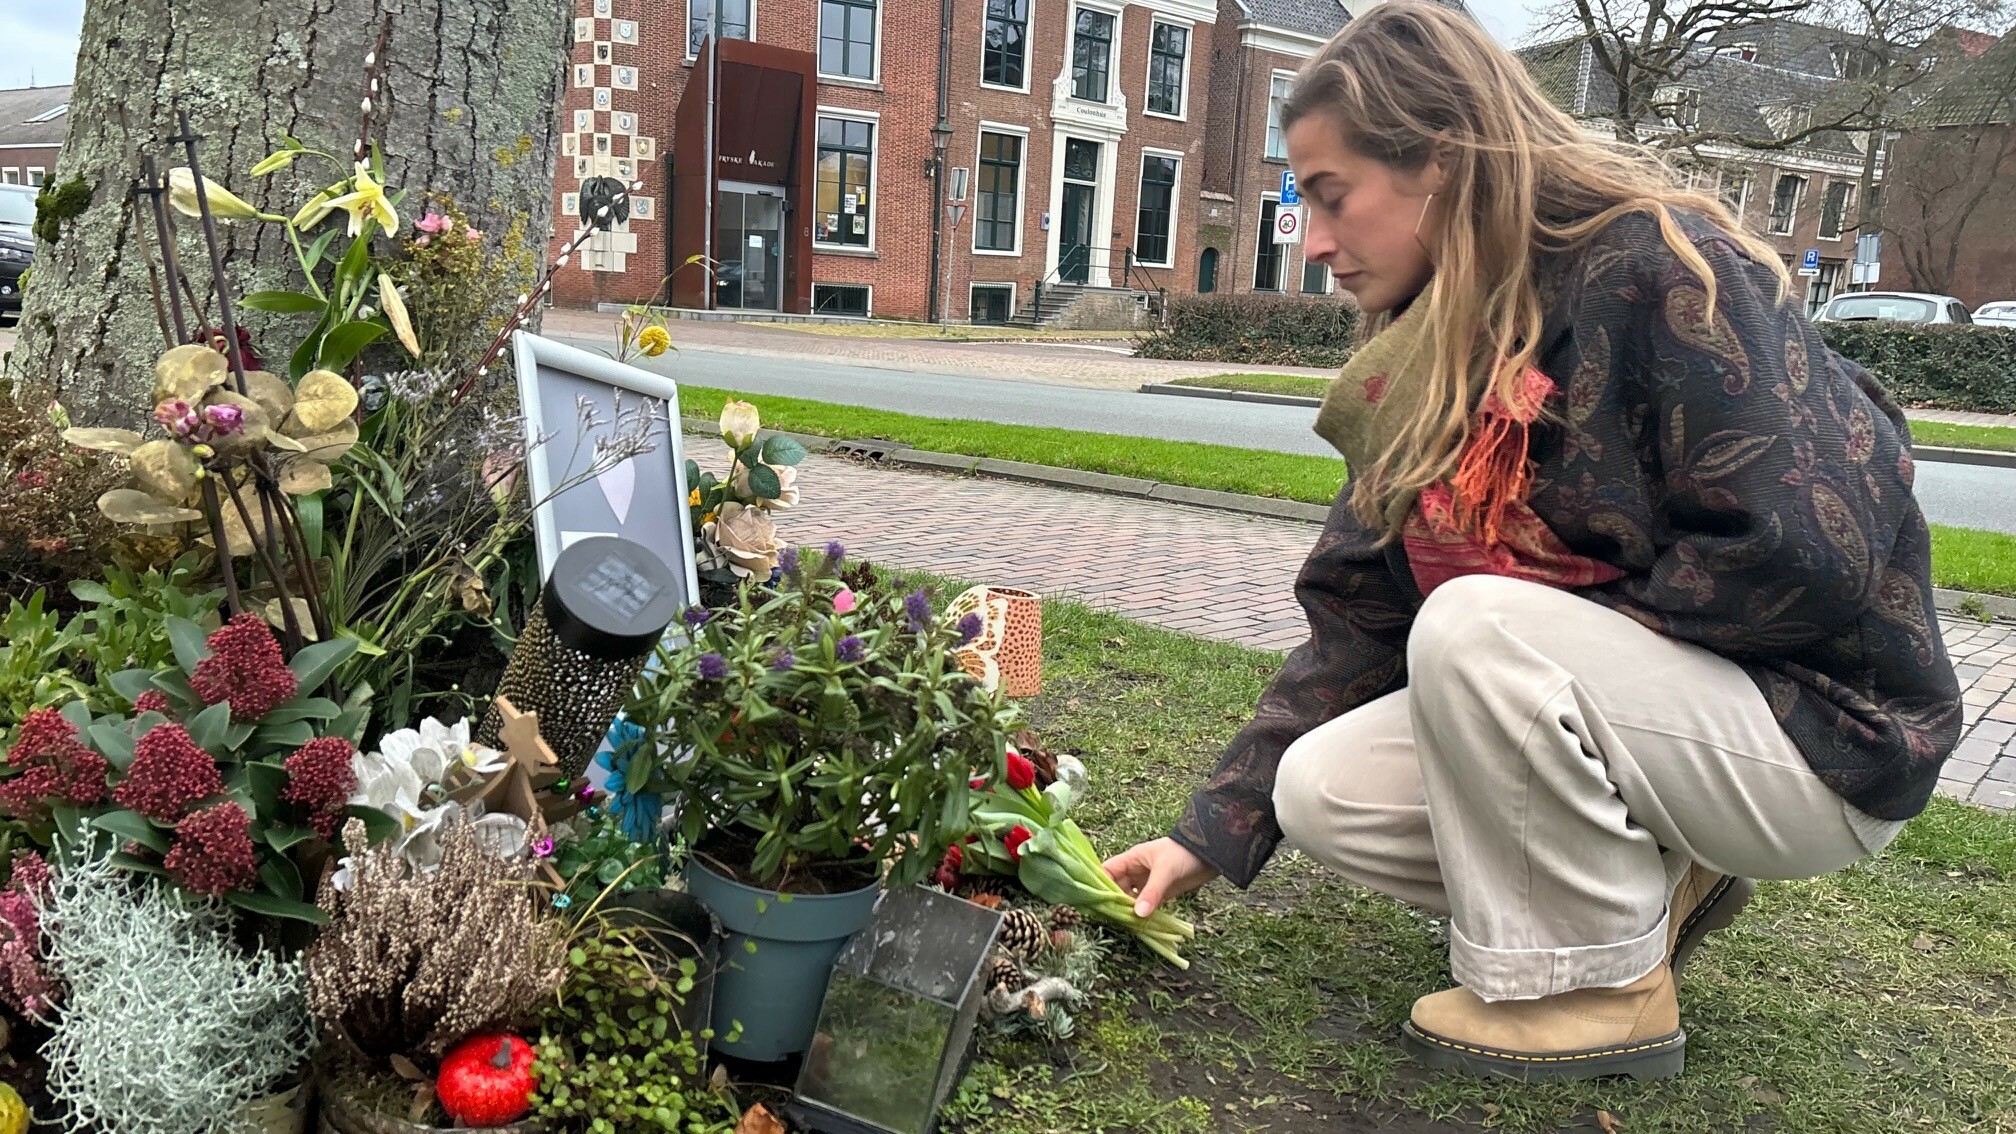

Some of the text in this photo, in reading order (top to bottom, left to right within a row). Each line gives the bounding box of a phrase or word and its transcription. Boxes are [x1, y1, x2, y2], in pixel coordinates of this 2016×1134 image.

[718, 155, 743, 164] FRYSKE
[1285, 173, 1295, 190] P
[803, 227, 810, 237] 8
